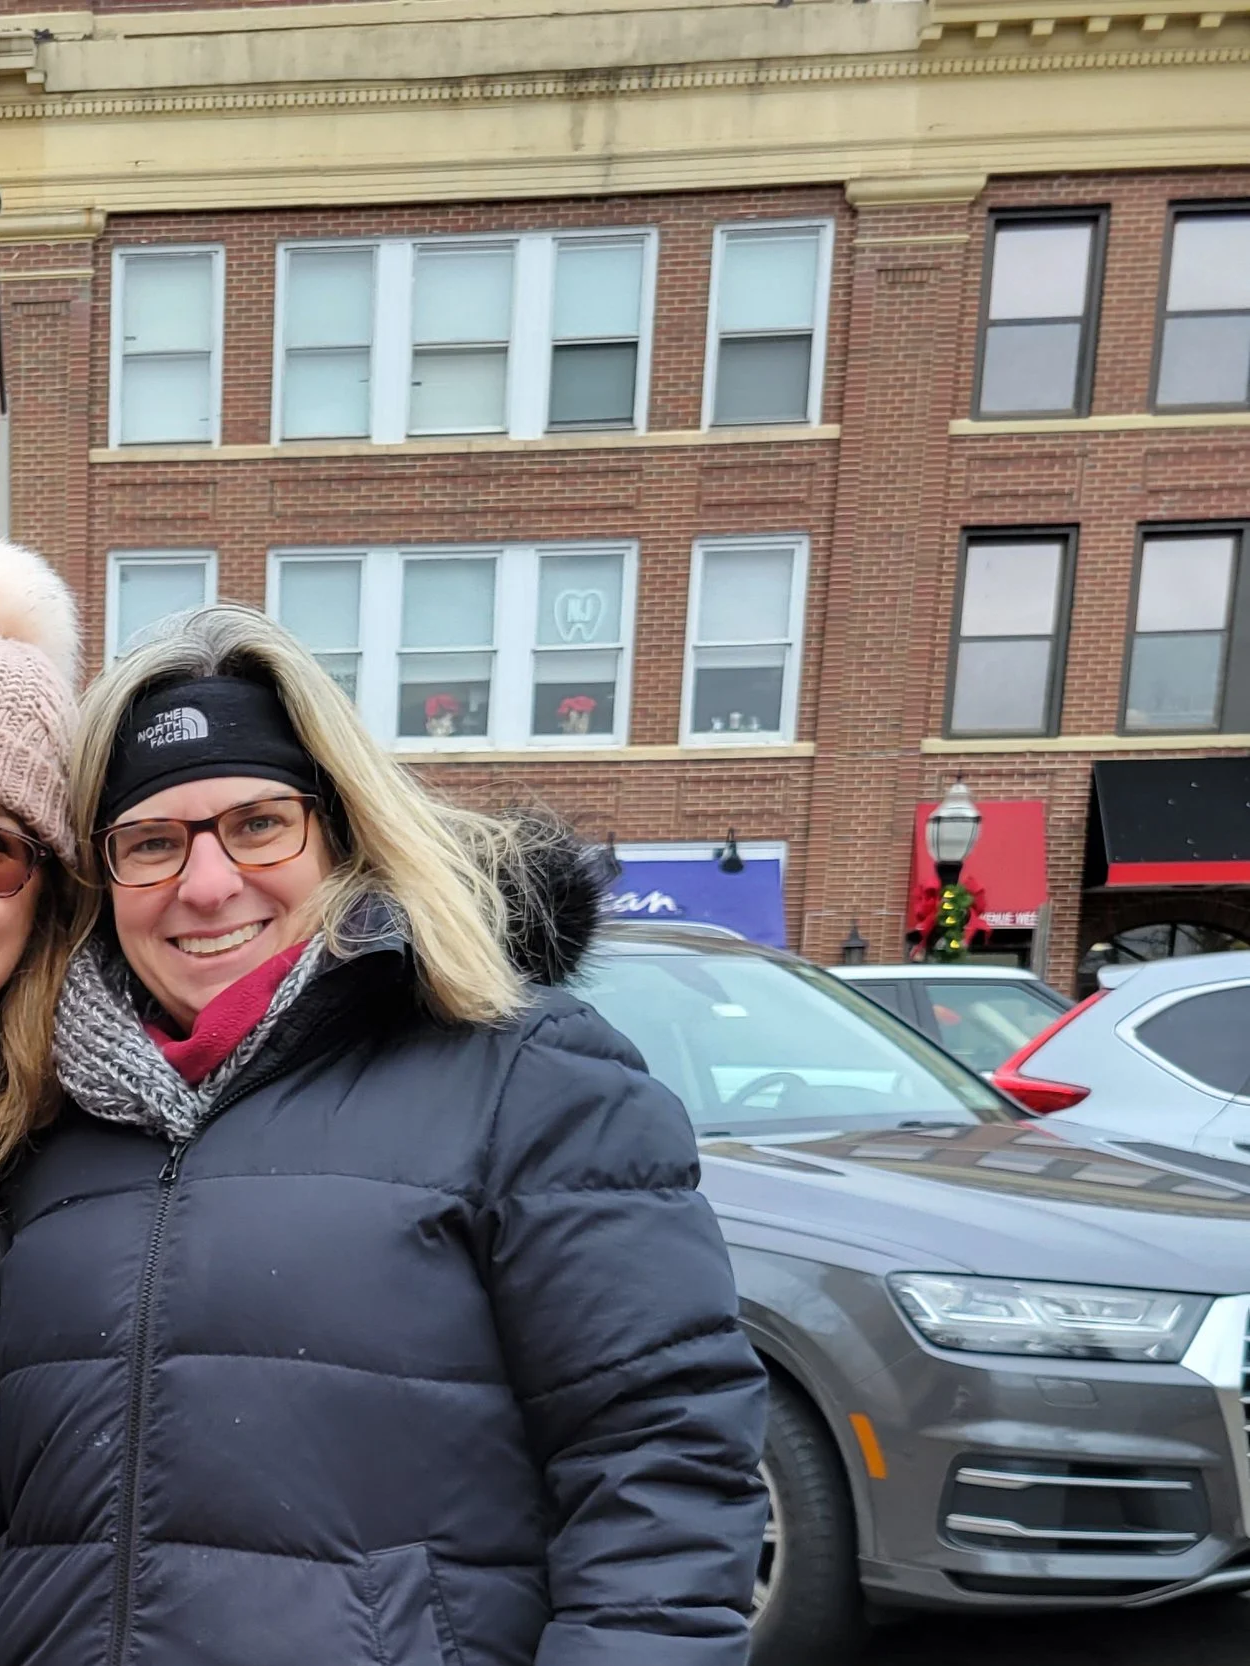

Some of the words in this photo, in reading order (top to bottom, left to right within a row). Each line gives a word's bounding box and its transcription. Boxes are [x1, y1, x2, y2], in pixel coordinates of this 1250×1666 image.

[155, 708, 182, 723] THE
[137, 719, 182, 743] NORTH
[150, 730, 183, 749] FACE
